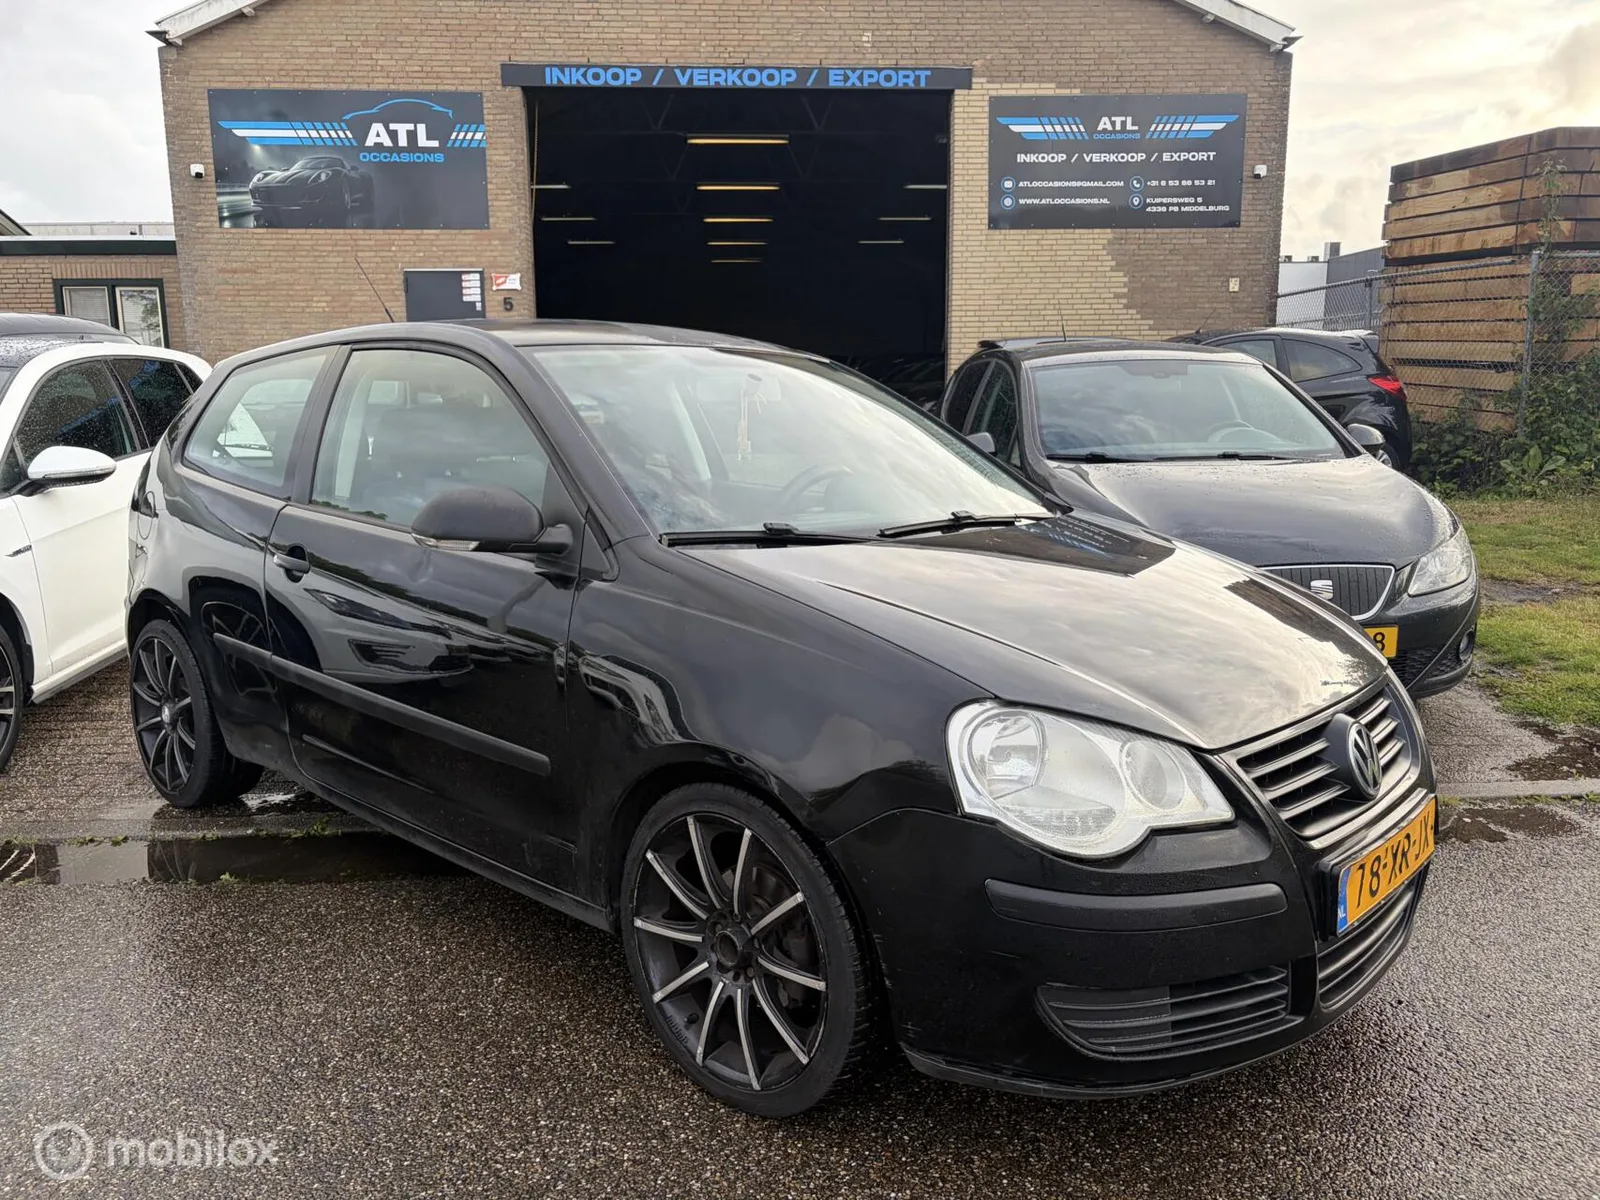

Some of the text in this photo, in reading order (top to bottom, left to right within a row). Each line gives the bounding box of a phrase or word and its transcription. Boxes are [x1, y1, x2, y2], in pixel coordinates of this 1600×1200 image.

[544, 67, 642, 86] INKOOP
[674, 67, 797, 87] VERKOOP
[828, 69, 932, 88] EXPORT
[1096, 116, 1139, 131] ATL
[364, 122, 440, 148] ATL
[359, 152, 445, 163] OCCASIONS
[1016, 153, 1067, 163] INKOOP
[1083, 152, 1146, 163] VERKOOP
[1162, 151, 1217, 162] EXPORT
[1018, 197, 1111, 205] WWW.ATLOCCASIONS.NL
[503, 297, 514, 312] 5
